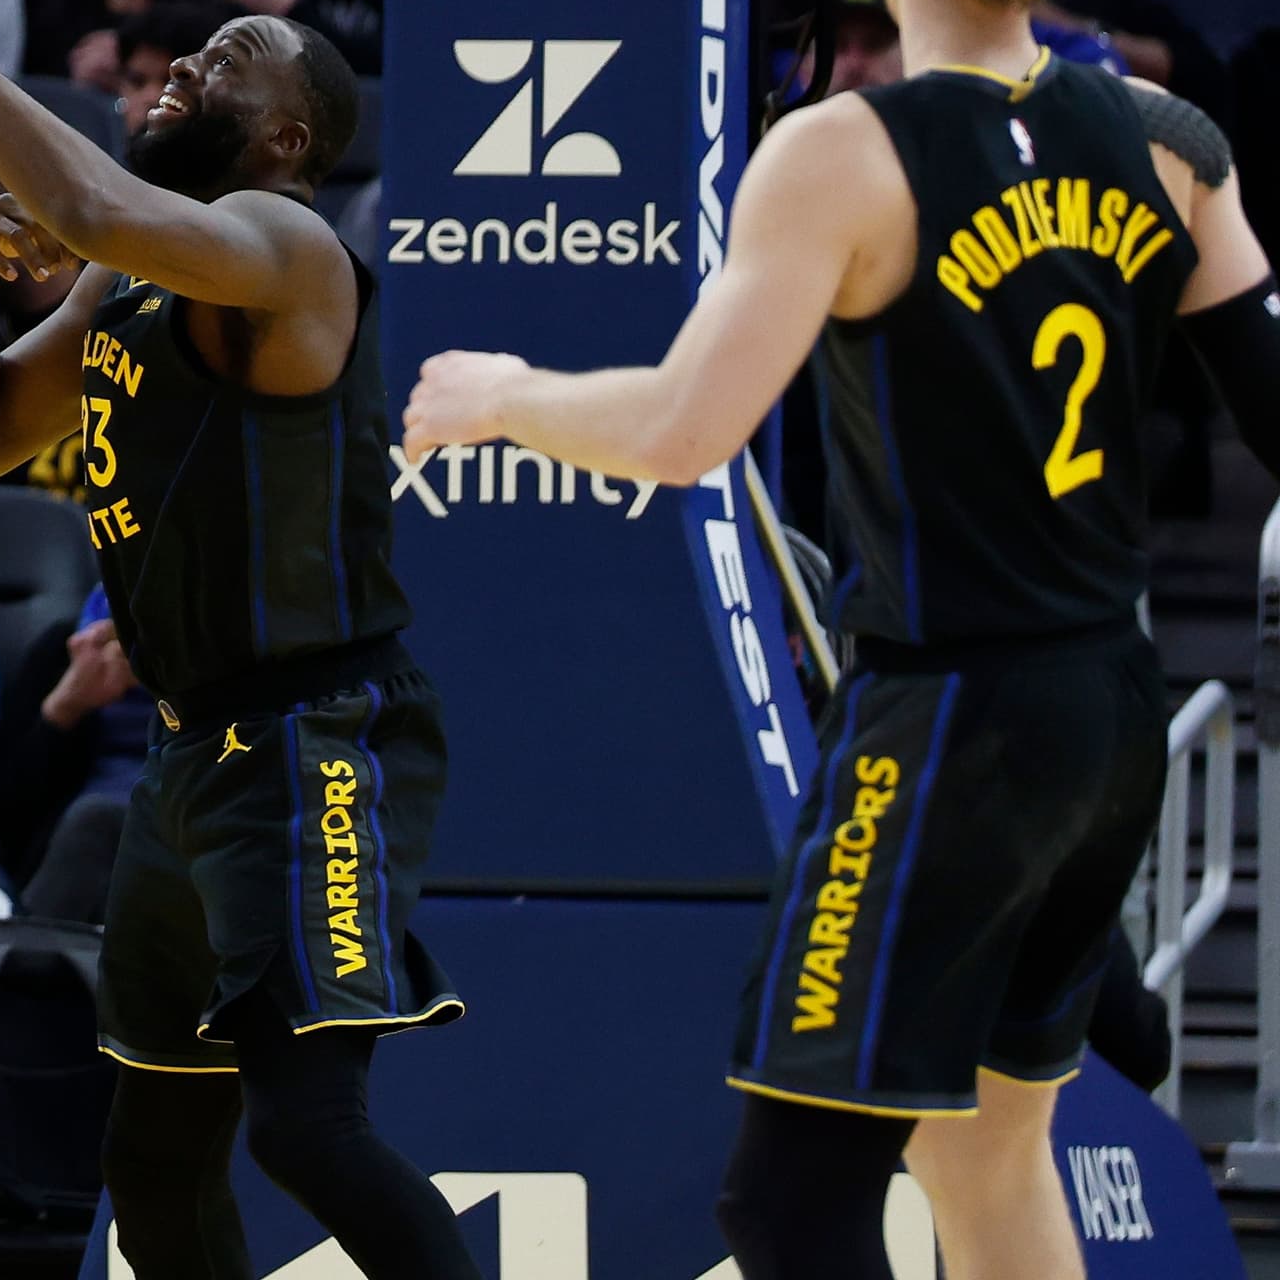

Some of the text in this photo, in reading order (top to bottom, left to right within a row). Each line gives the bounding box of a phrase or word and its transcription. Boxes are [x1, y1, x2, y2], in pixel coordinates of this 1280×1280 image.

[388, 201, 682, 265] zendesk
[936, 176, 1176, 313] PODZIEMSKI
[82, 329, 144, 398] LDEN
[1031, 302, 1107, 500] 2
[81, 394, 117, 488] 3
[319, 759, 368, 979] WARRIORS
[791, 754, 901, 1033] WARRIORS
[1066, 1144, 1155, 1241] KAISER
